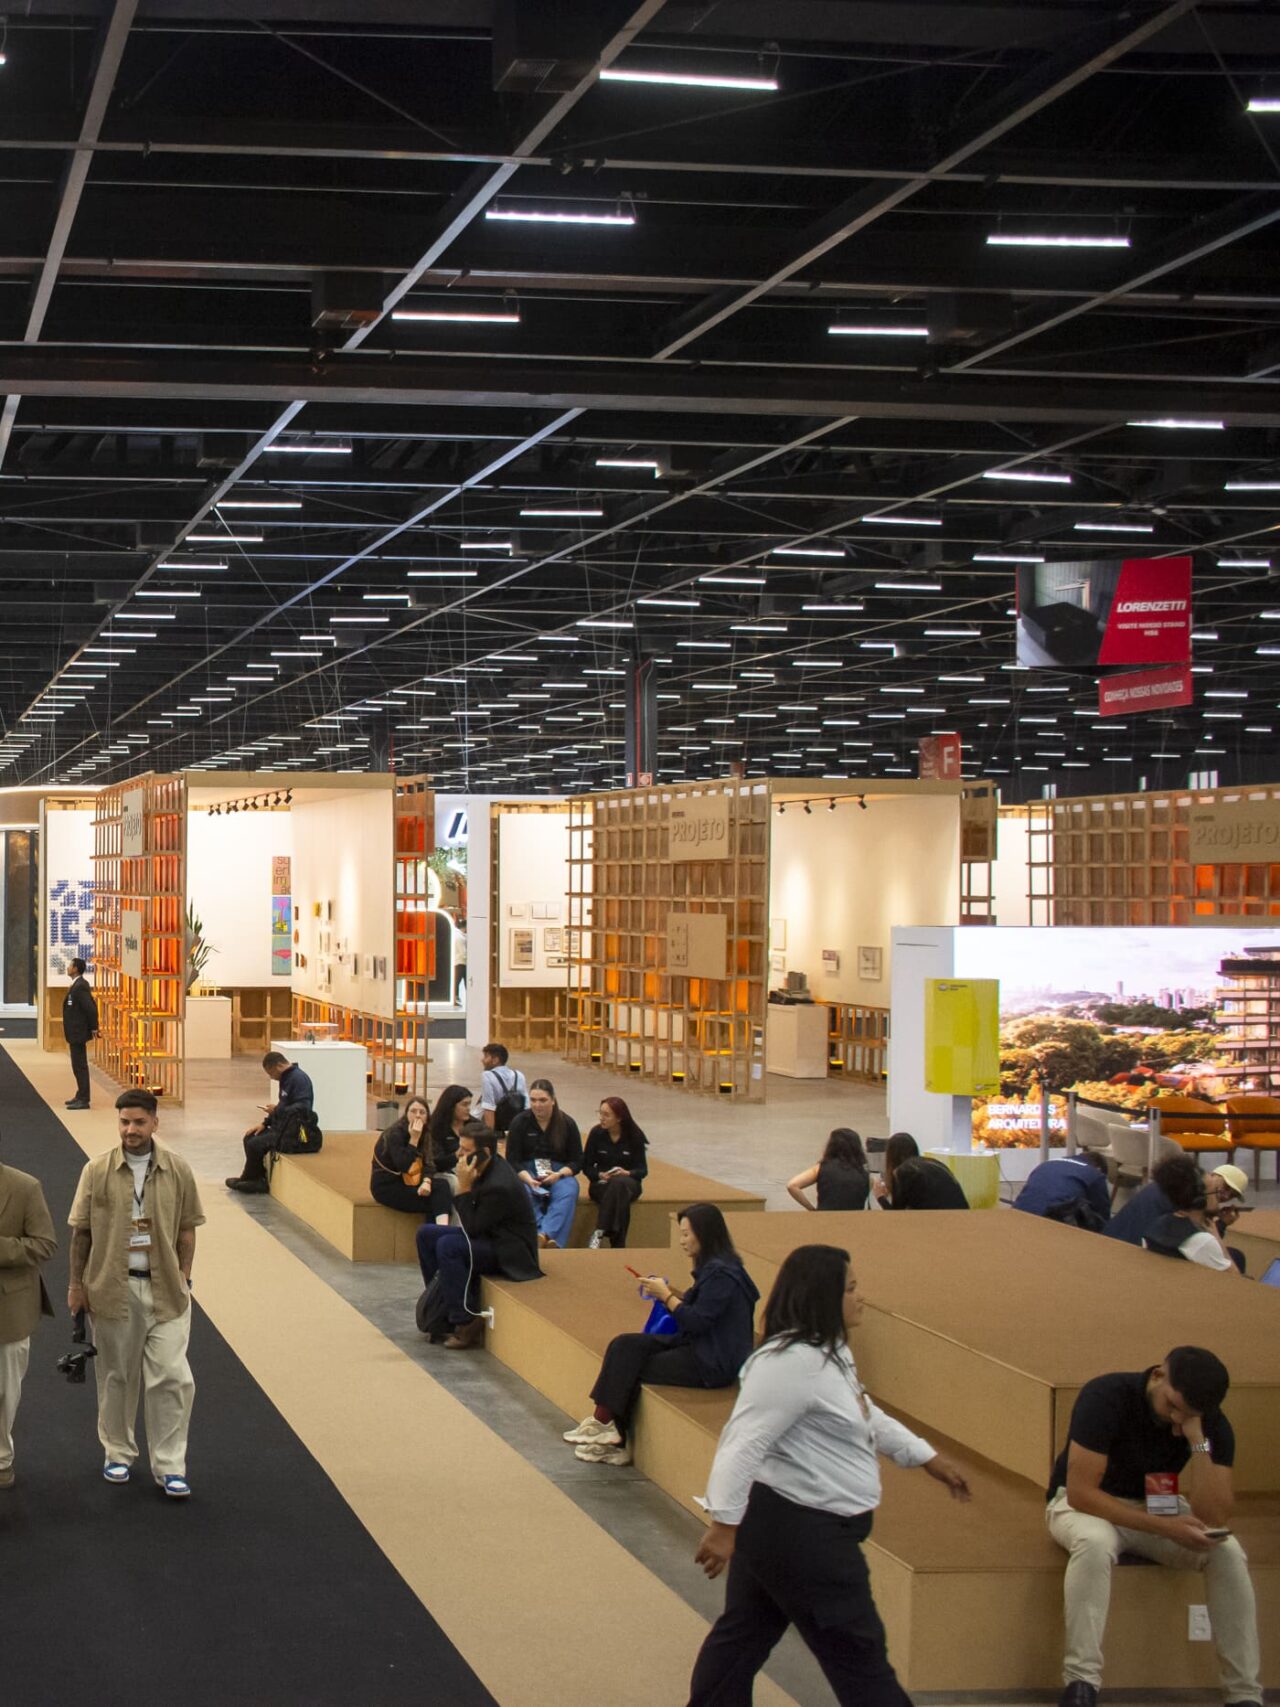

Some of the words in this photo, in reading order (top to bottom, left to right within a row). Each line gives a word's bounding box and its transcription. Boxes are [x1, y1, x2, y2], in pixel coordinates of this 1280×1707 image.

[1117, 601, 1186, 612] LORENZETTI
[943, 746, 955, 774] F
[671, 818, 726, 847] PROJETO
[988, 1104, 1056, 1115] BERNARDS
